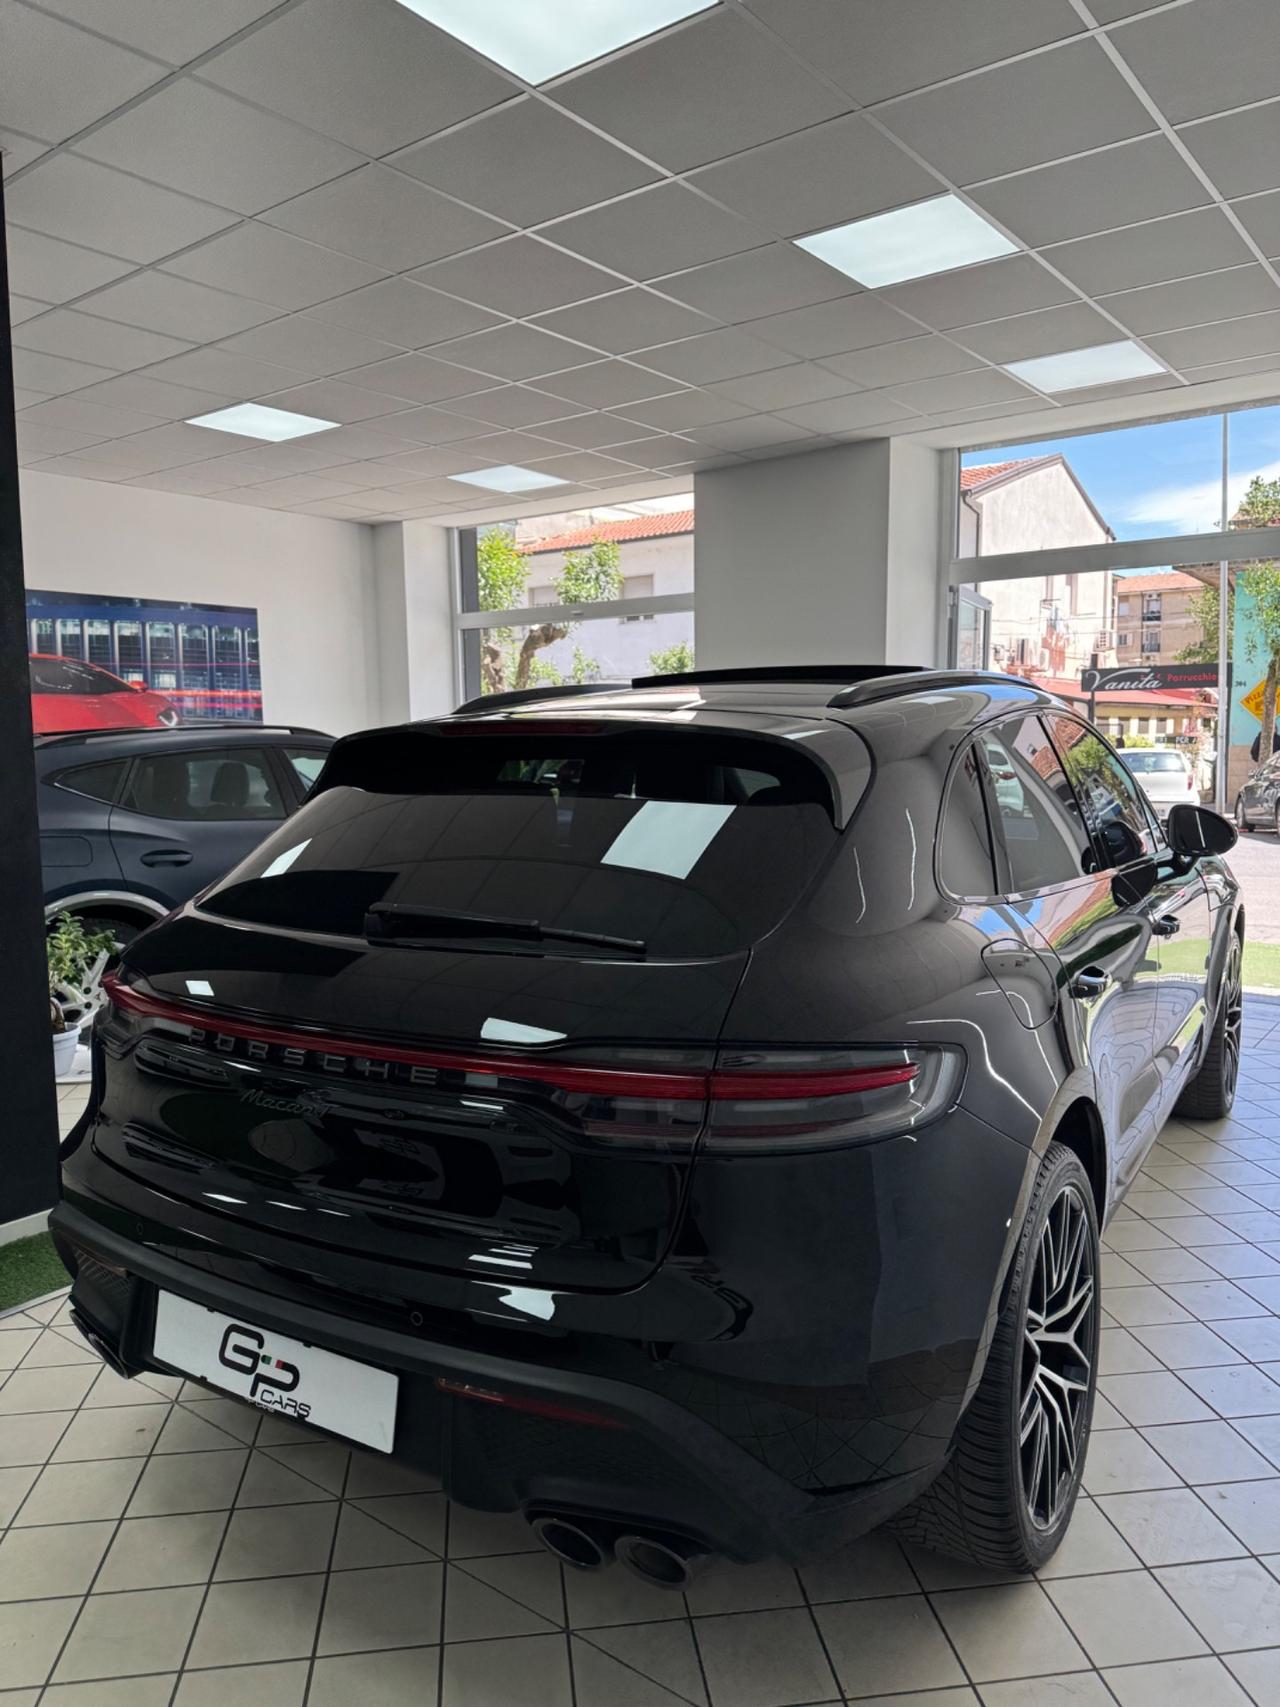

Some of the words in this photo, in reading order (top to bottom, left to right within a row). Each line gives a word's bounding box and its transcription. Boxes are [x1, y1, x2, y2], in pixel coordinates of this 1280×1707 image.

[1167, 672, 1217, 682] Parrucchie
[187, 1029, 439, 1085] PORSCHE
[239, 1088, 315, 1114] Macan
[259, 1388, 312, 1418] CARS
